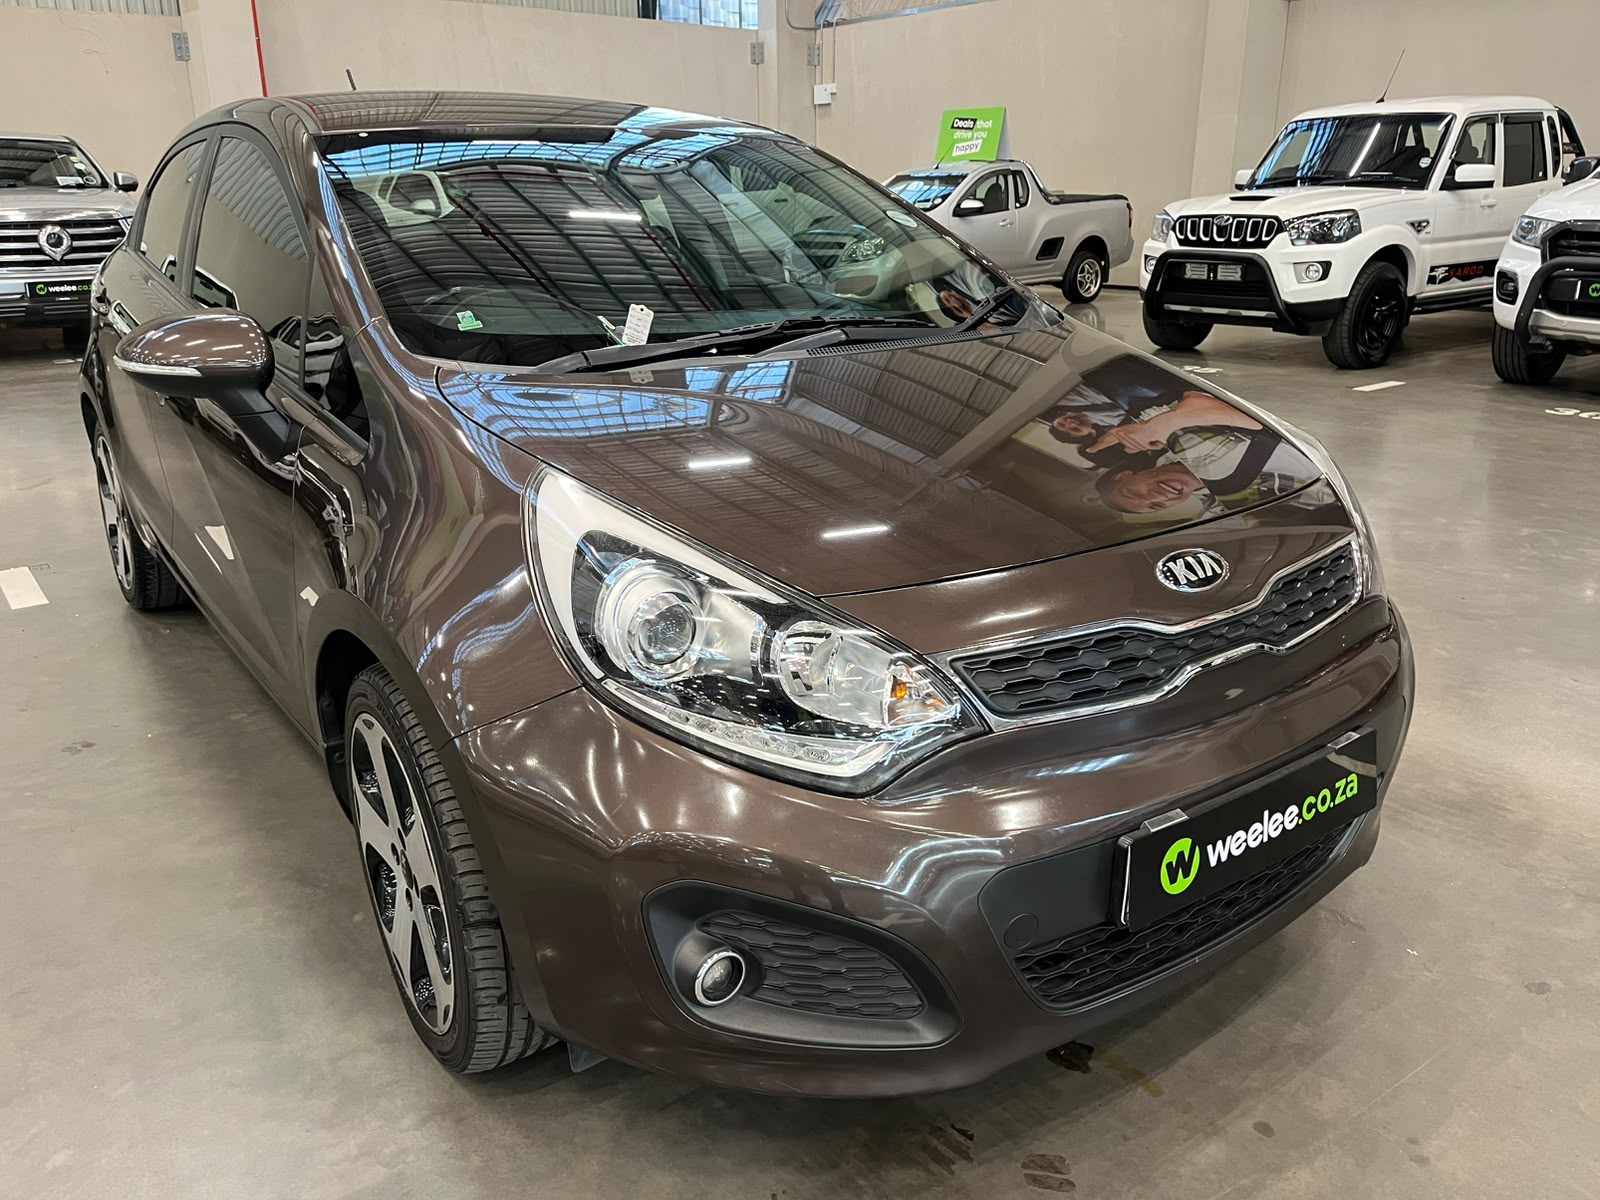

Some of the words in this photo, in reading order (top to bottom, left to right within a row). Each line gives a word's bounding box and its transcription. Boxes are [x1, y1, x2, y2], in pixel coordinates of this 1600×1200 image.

[953, 118, 975, 128] Deals
[976, 119, 993, 129] that
[953, 129, 972, 140] drive
[973, 130, 988, 141] you
[954, 141, 981, 153] happy
[1449, 264, 1485, 278] KAROO
[1165, 552, 1223, 585] KIA
[1206, 773, 1359, 868] weelee.co.za
